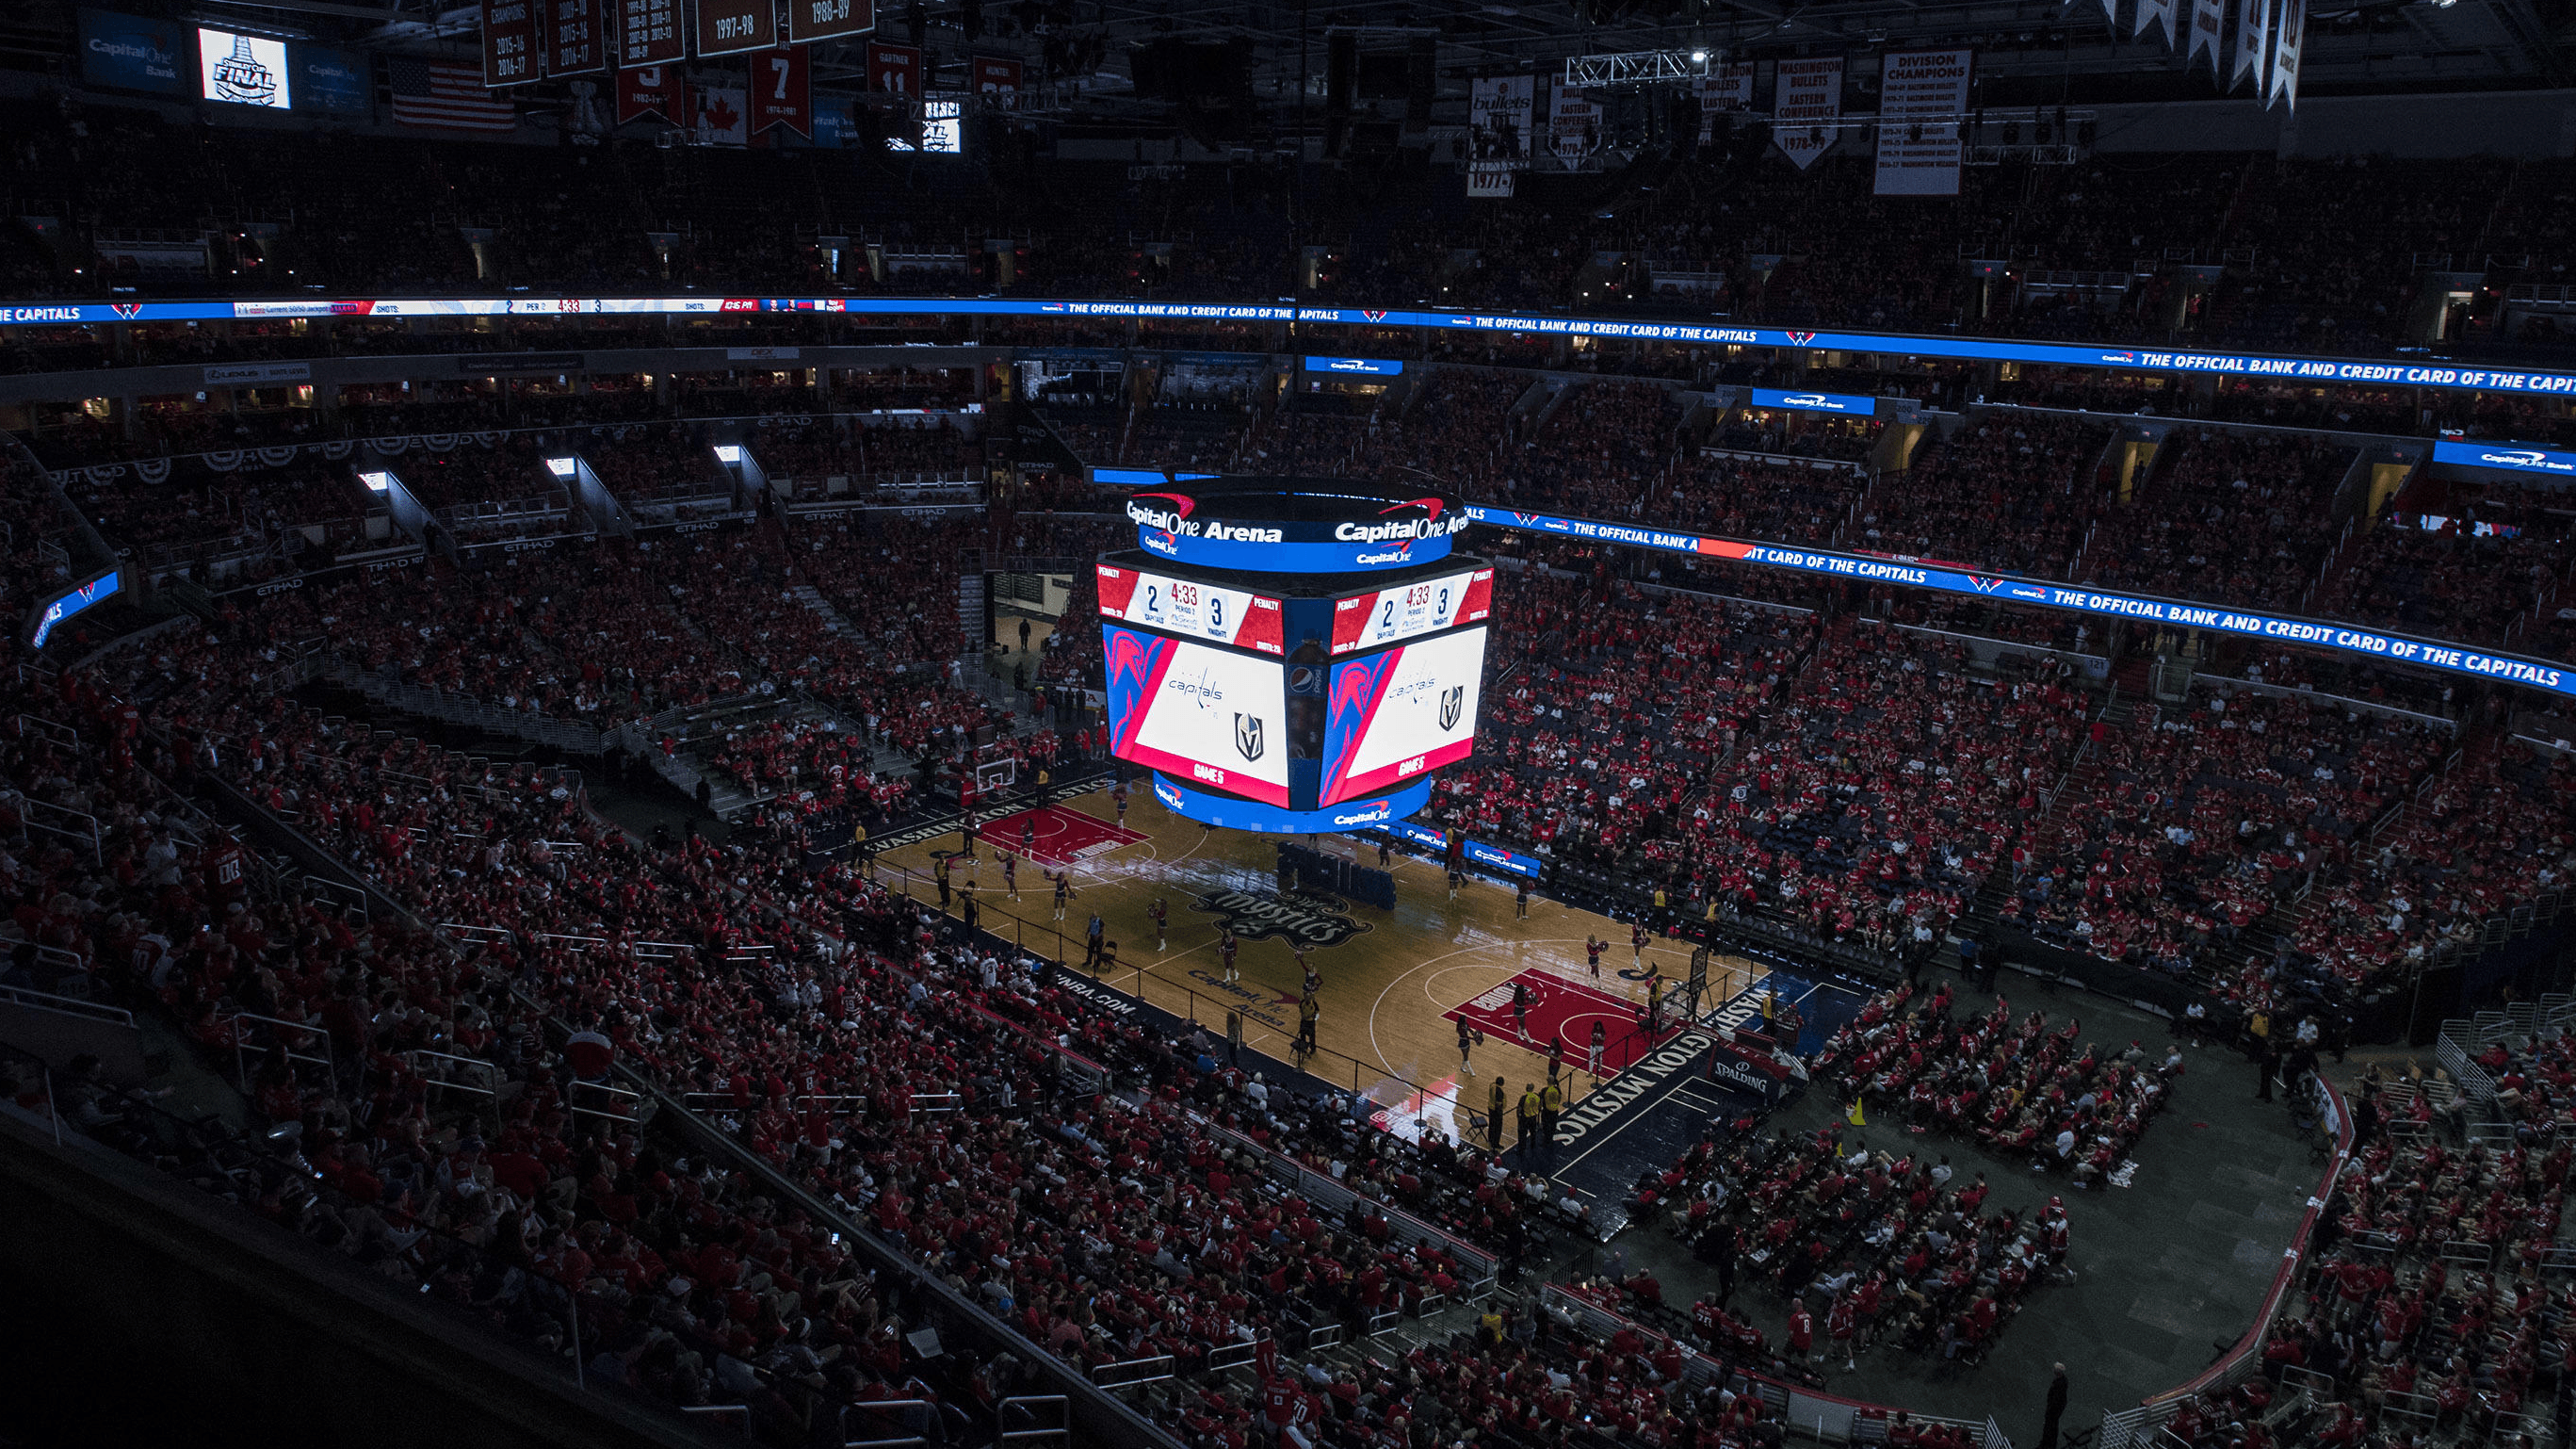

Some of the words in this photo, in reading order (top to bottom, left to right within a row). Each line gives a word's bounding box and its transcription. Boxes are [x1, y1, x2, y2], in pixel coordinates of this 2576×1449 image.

[812, 0, 850, 24] 1988-89
[559, 21, 588, 44] 2015-16
[651, 26, 672, 41] 2012-13
[716, 14, 754, 40] 1997-98
[496, 34, 525, 55] 2015-16
[560, 44, 589, 67] 2016-17
[1899, 55, 1956, 67] DIVISION
[145, 65, 176, 79] Bank
[498, 56, 526, 76] 2016-17
[1780, 61, 1842, 74] WASHINGTON
[1887, 67, 1965, 80] CHAMPIONS
[214, 65, 277, 90] FINAL
[771, 58, 790, 100] 7
[1705, 79, 1741, 92] BULLETS
[1790, 75, 1828, 88] BULLETS
[1473, 95, 1531, 110] bullets
[1790, 93, 1826, 105] EASTERN
[1779, 106, 1835, 118] CONFERENCE
[377, 304, 399, 313] SHOTS:
[506, 301, 513, 314] 2
[558, 300, 580, 313] 4:33
[594, 300, 601, 313] 3
[742, 301, 753, 309] PM
[1069, 304, 1089, 313] THE
[1091, 304, 1136, 314] OFFICIAL
[1139, 305, 1165, 314] BANK
[1168, 306, 1189, 315] AND
[1191, 307, 1227, 316] CREDIT
[1229, 308, 1256, 317] CARD
[1258, 308, 1272, 317] OF
[1274, 309, 1292, 317] THE
[1299, 310, 1338, 319] APITALS
[16, 308, 79, 320] CAPITALS
[1476, 317, 1494, 327] THE
[1496, 318, 1537, 330] OFFICIAL
[1540, 320, 1567, 331] BANK
[1569, 322, 1590, 332] AND
[1593, 323, 1629, 334] CREDIT
[1631, 325, 1660, 336] CARD
[1662, 327, 1677, 337] OF
[1680, 328, 1701, 338] THE
[1704, 330, 1757, 342] CAPITALS
[2143, 353, 2172, 366] THE
[2175, 355, 2244, 370] OFFICIAL
[2249, 360, 2293, 373] BANK
[2298, 363, 2335, 376] AND
[2341, 365, 2404, 380] CREDIT
[2407, 368, 2455, 383] CARD
[2461, 372, 2485, 384] OF
[2490, 374, 2525, 388] THE
[2546, 461, 2574, 470] Bank
[901, 508, 947, 516] ETIHAD
[675, 521, 720, 533] ETIHAD
[1204, 522, 1283, 543] Arena
[1575, 523, 1596, 535] THE
[1598, 527, 1649, 543] OFFICIAL
[1653, 534, 1687, 548] BANK
[505, 540, 555, 552] ETIHAD
[1098, 566, 1120, 578] PENALTY
[1768, 550, 1803, 564] CARD
[1806, 556, 1825, 568] OF
[1829, 559, 1855, 573] THE
[1858, 563, 1926, 583] CAPITALS
[1473, 570, 1492, 582] PENALTY
[256, 579, 303, 596] ETIHAD
[1172, 583, 1198, 606] 4:33
[1148, 585, 1158, 612] 2
[1254, 597, 1279, 611] PENALTY
[1337, 598, 1360, 611] PENALTY
[1406, 585, 1430, 608] 4:33
[1437, 588, 1449, 615] 3
[1144, 612, 1164, 625] CAPITALS
[1211, 598, 1223, 626] 3
[1383, 600, 1394, 628] 2
[1207, 627, 1227, 639] KNIGHTS
[2055, 591, 2086, 606] THE
[2090, 595, 2163, 617] OFFICIAL
[2168, 607, 2218, 626] BANK
[2221, 615, 2260, 630] AND
[2266, 621, 2334, 642] CREDIT
[2338, 632, 2386, 651] CARD
[2391, 642, 2418, 657] OF
[2423, 647, 2461, 666] THE
[2466, 656, 2560, 686] CAPITALS
[1169, 673, 1223, 705] capitals
[1194, 764, 1217, 782] GAME
[1217, 771, 1224, 784] 5
[1399, 758, 1418, 776] GAME
[1418, 756, 1425, 771] 5
[1234, 1004, 1286, 1027] Arena
[1715, 1062, 1767, 1093] SPALDING
[1552, 1071, 1658, 1147] MYSTICS
